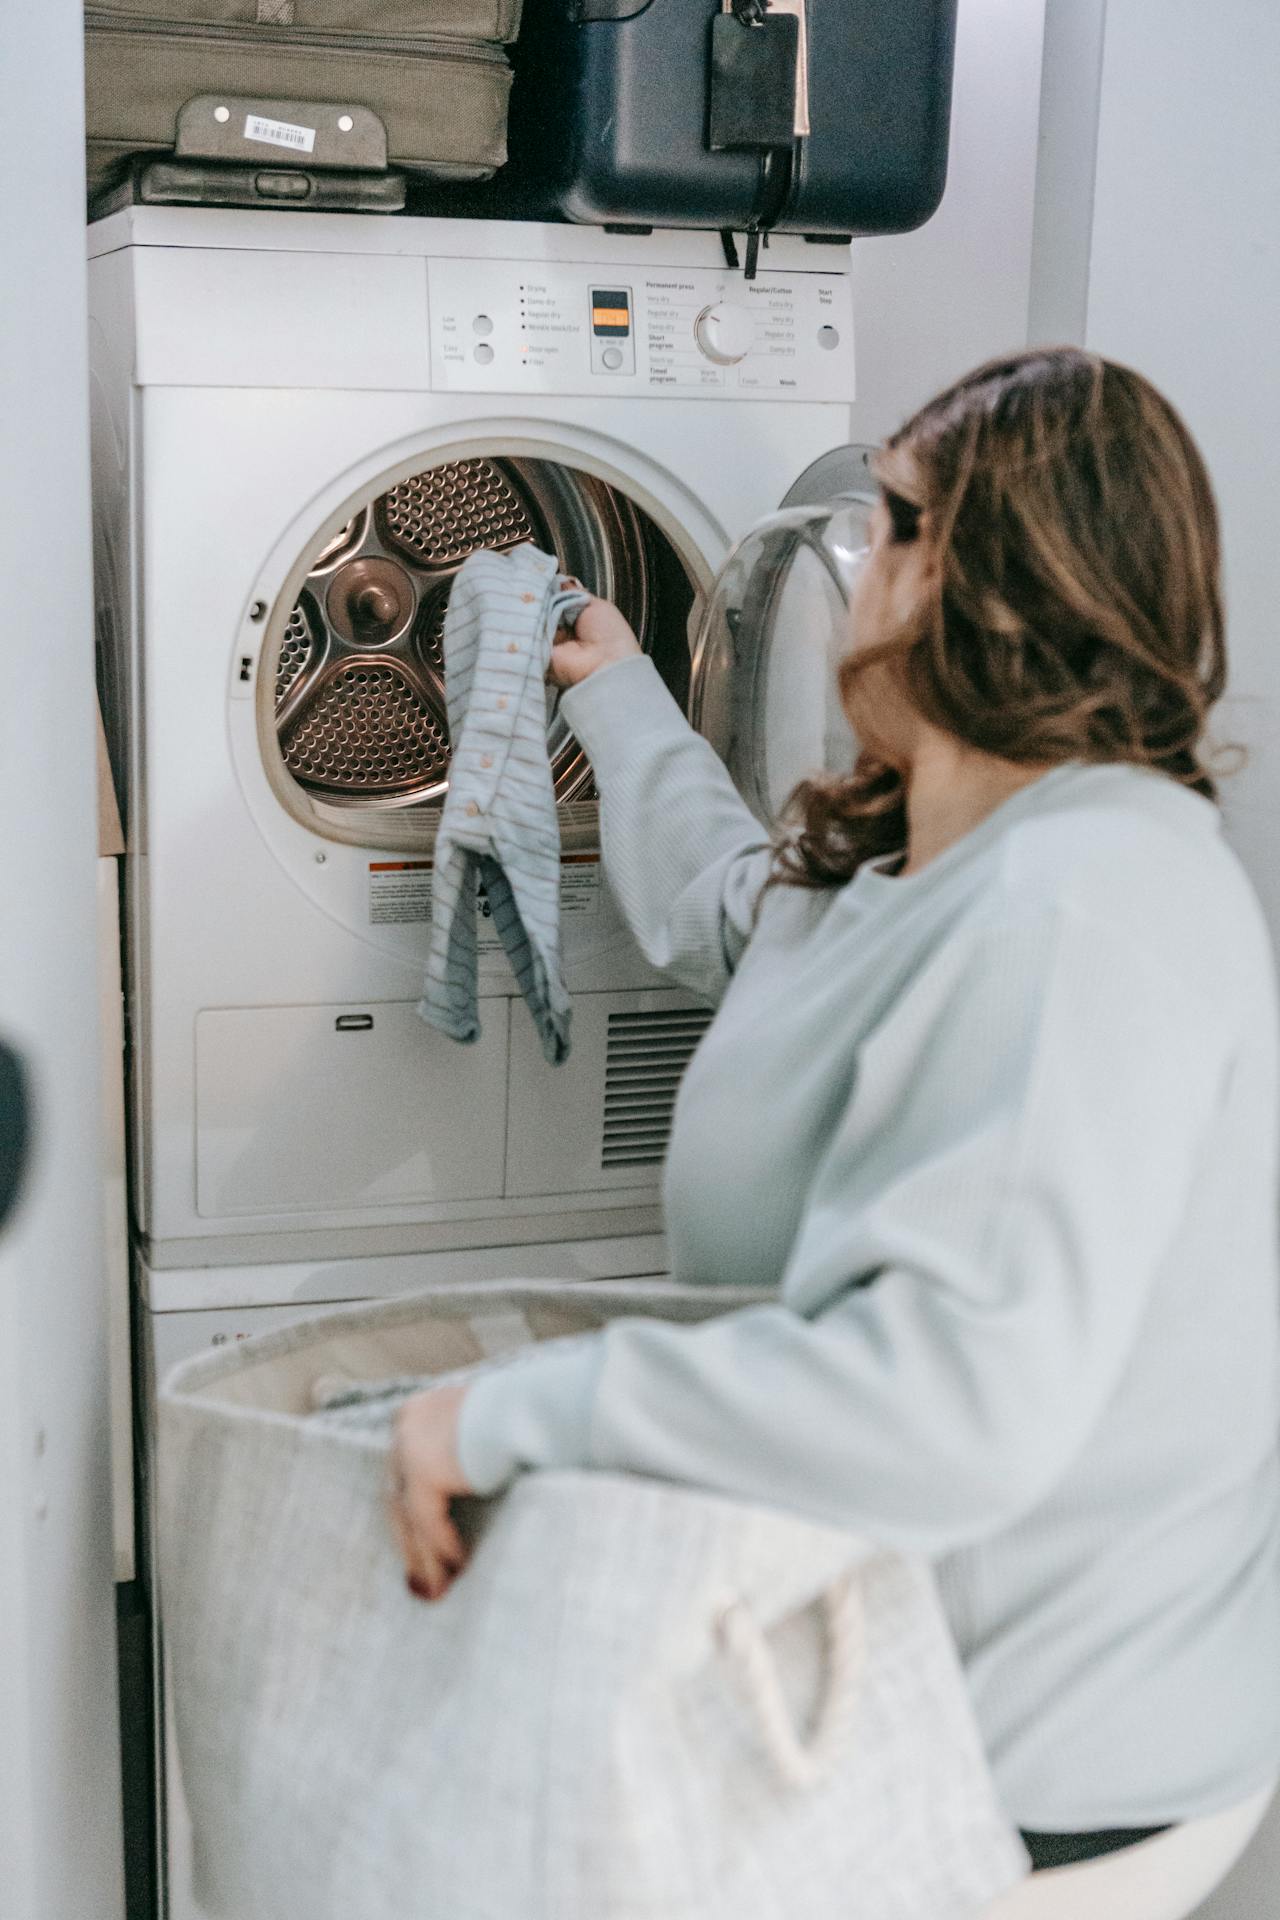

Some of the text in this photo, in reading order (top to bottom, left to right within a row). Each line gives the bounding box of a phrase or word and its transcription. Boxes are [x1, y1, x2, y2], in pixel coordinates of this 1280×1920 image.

[678, 283, 695, 291] press
[749, 286, 792, 294] Regular/Cotton
[649, 342, 673, 350] program
